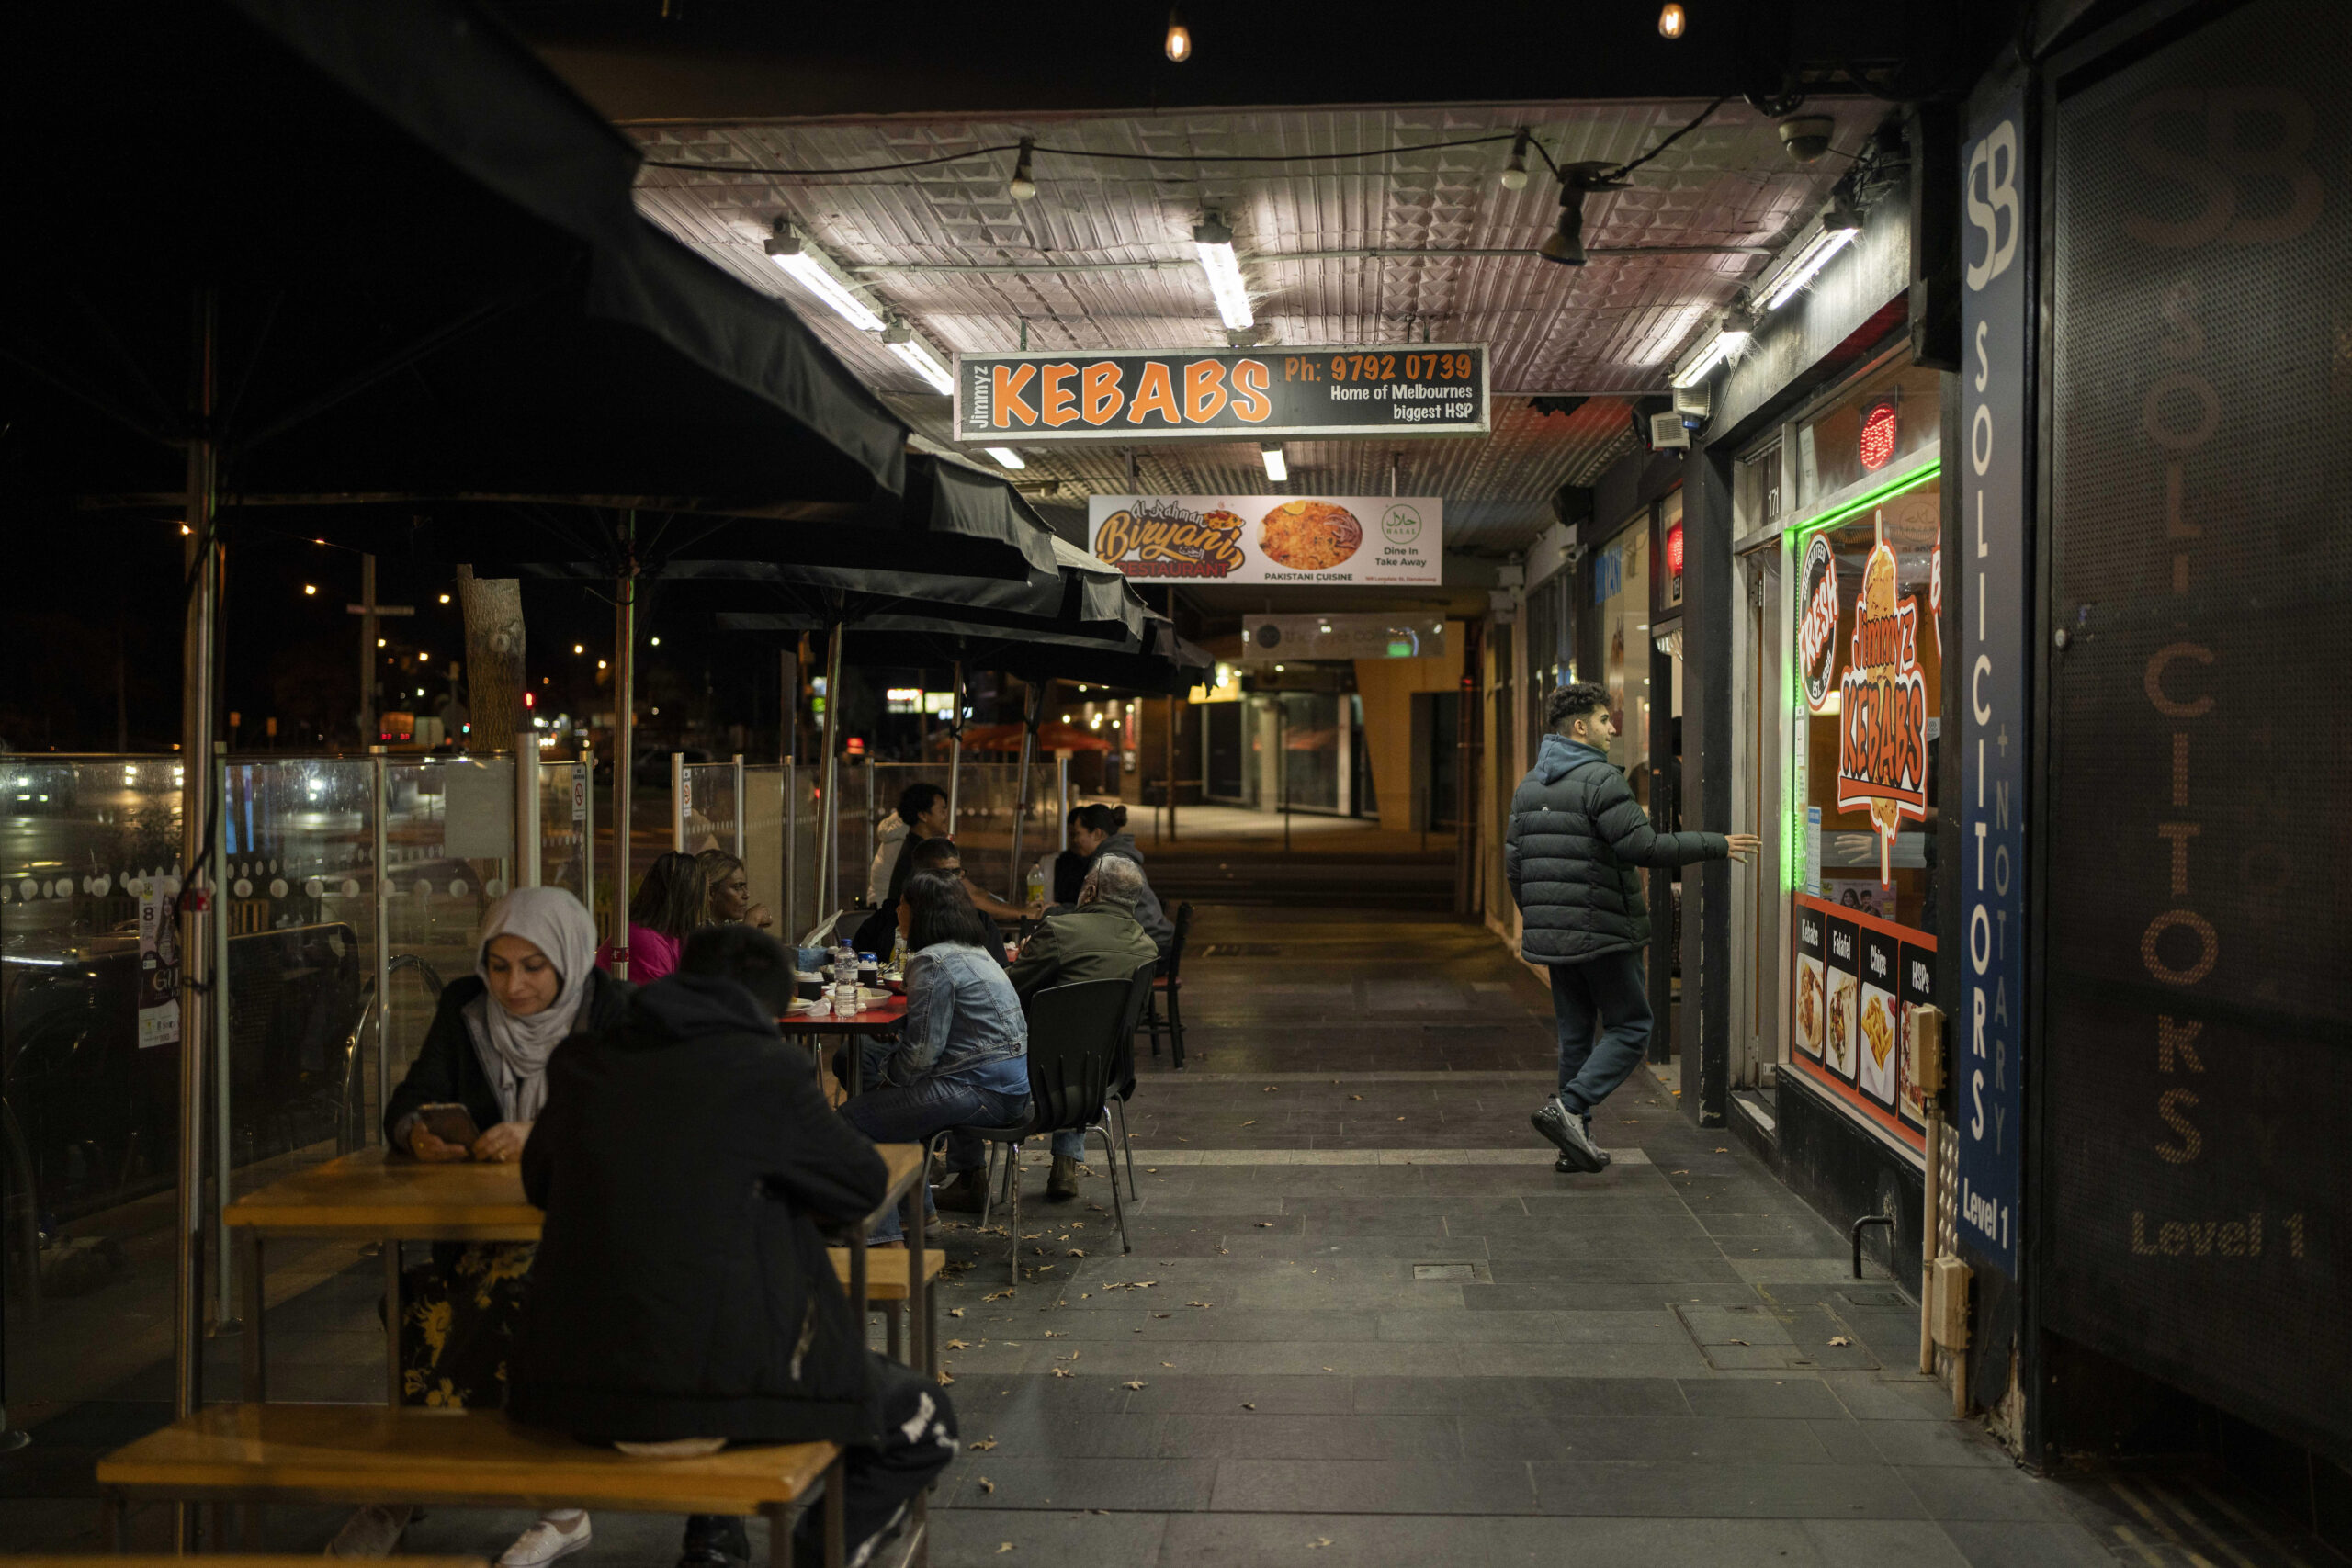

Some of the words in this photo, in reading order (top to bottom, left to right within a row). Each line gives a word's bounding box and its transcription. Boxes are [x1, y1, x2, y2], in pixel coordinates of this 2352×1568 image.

[1966, 119, 2019, 291] SB
[1285, 356, 1321, 382] Ph:
[1331, 355, 1396, 382] 9792
[1405, 353, 1472, 380] 0739
[969, 365, 992, 429] Jimmyz
[992, 358, 1272, 428] KEBABS
[1330, 385, 1370, 400] Home
[1374, 384, 1388, 400] of
[1392, 383, 1473, 400] Melbournes
[1394, 403, 1442, 422] biggest
[1445, 402, 1474, 420] HSP
[1768, 487, 1779, 517] 171
[1096, 511, 1244, 570] Biryani
[1384, 547, 1407, 555] Dine
[1117, 562, 1228, 578] RESTAURANT
[1375, 558, 1397, 566] Take
[1400, 558, 1427, 568] Away
[1798, 558, 1838, 684] FRESH
[1841, 678, 1923, 792] KEBABS
[1970, 320, 1993, 1142] SOLICITORS
[1802, 918, 1819, 947] Kebabs
[1833, 930, 1851, 961] Falafel
[1870, 943, 1887, 978] Chips
[1912, 960, 1930, 994] HSPs
[1994, 780, 2010, 1156] NOTARY
[1962, 1177, 1997, 1241] Level
[2000, 1206, 2008, 1249] 1
[2132, 1209, 2264, 1258] Level
[2281, 1211, 2304, 1258] 1
